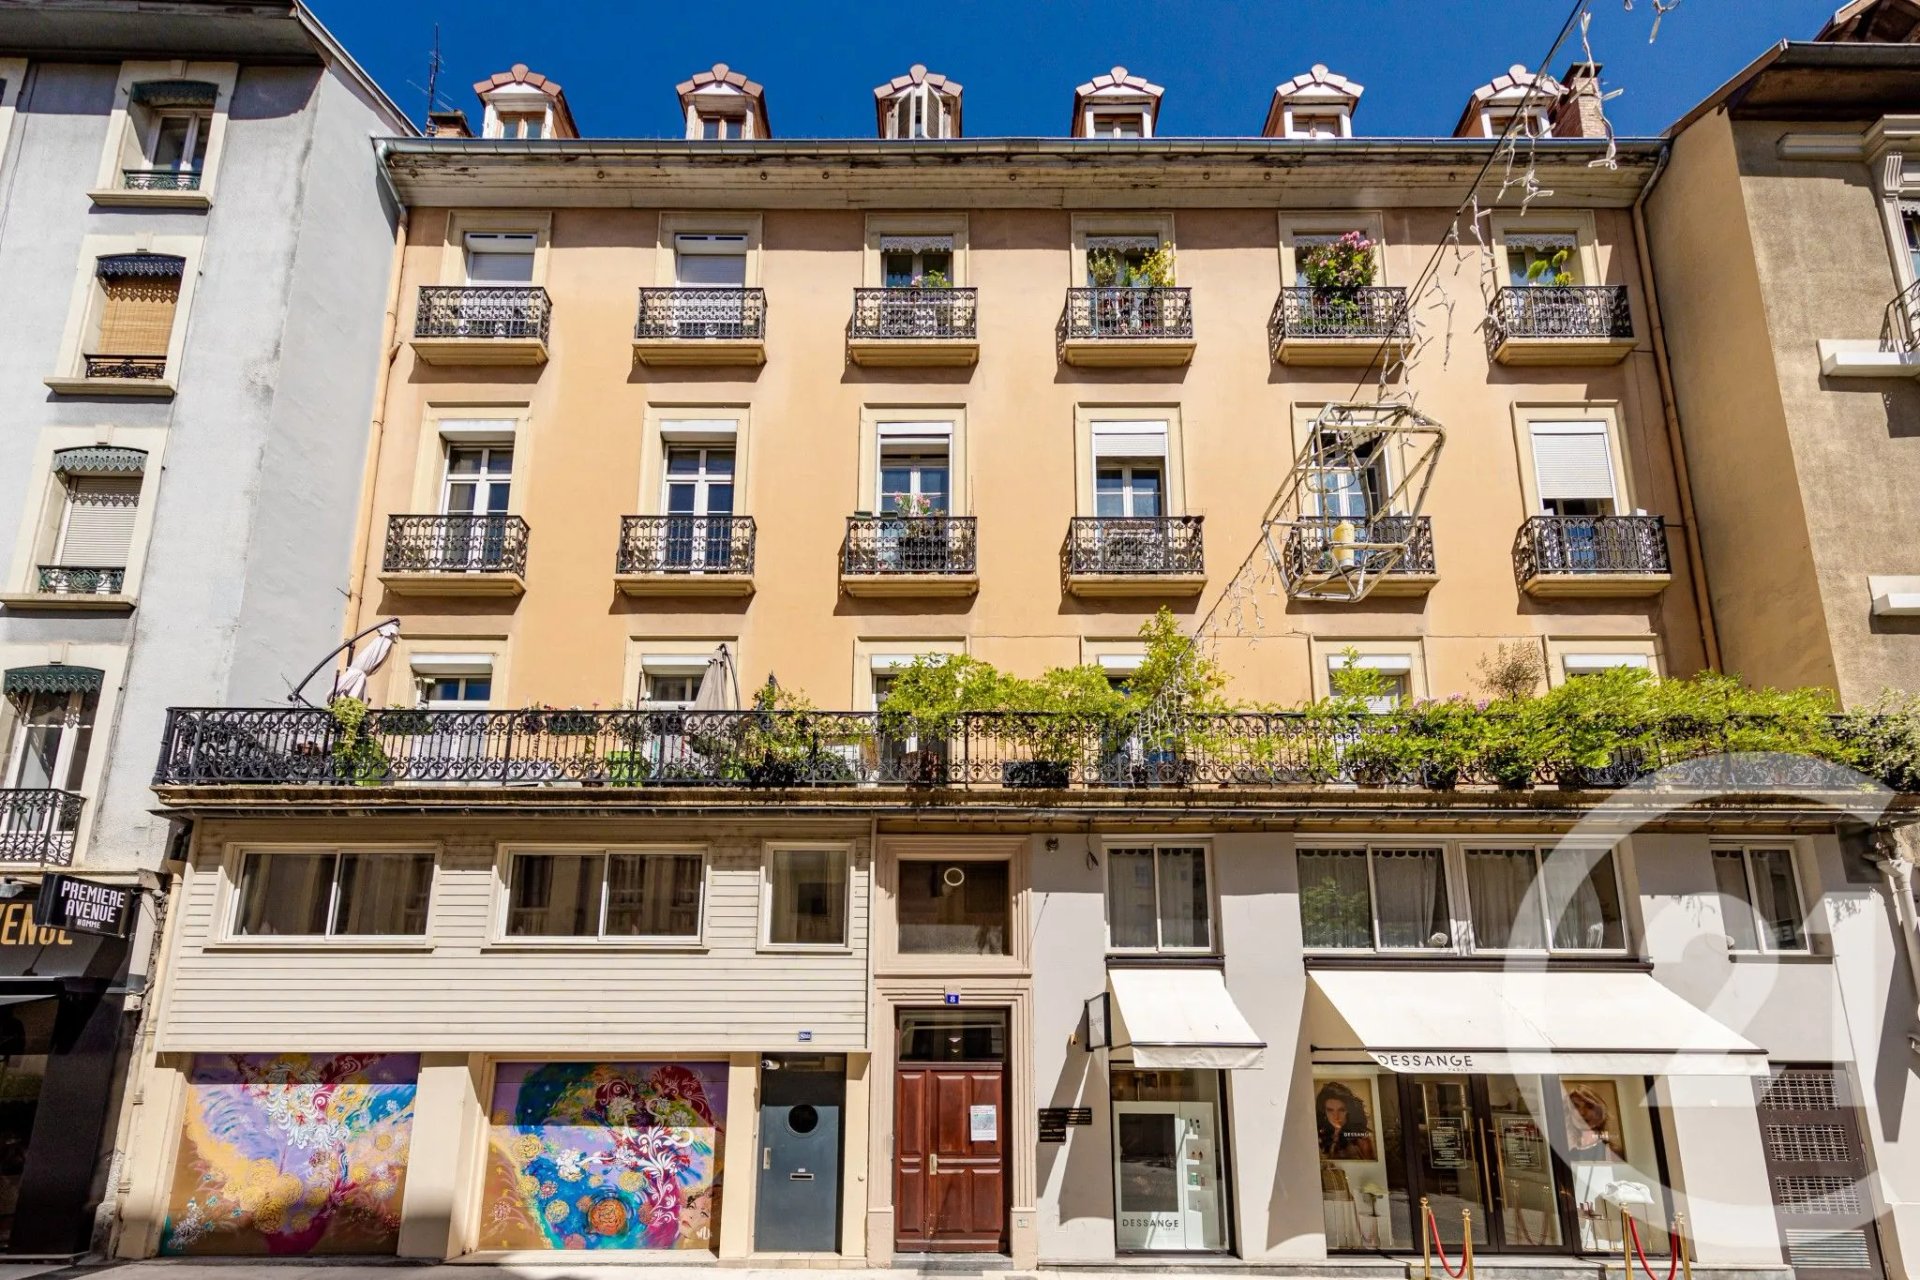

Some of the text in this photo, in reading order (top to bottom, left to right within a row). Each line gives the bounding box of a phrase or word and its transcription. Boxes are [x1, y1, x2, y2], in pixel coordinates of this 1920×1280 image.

[61, 880, 126, 908] PREMIERE
[65, 899, 117, 923] AVENUE
[76, 918, 101, 929] HOMME
[949, 995, 957, 1003] 8
[1377, 1055, 1473, 1067] DESSANGE
[1122, 1219, 1179, 1228] DESSANGE
